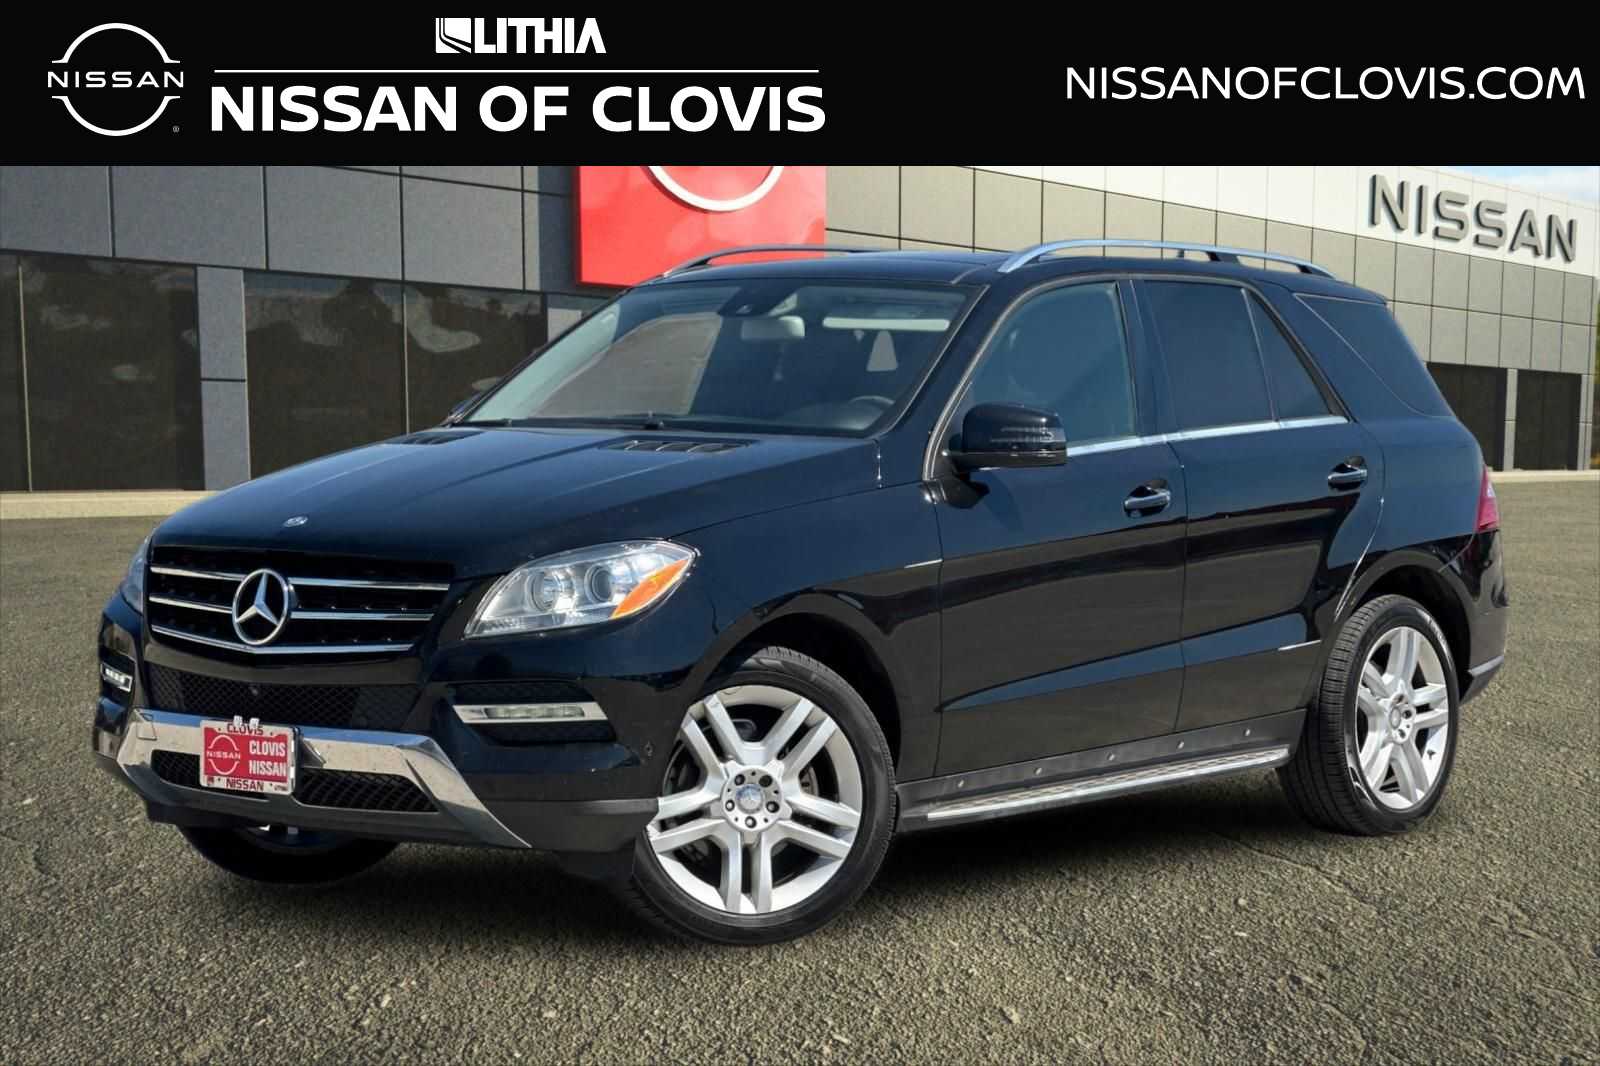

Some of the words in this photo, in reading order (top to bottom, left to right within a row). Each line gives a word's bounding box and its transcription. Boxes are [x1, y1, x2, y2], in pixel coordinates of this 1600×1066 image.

[1368, 173, 1577, 263] NISSAN
[206, 750, 241, 759] NISSAN
[249, 740, 286, 757] CLOVIS
[249, 760, 287, 777] NISSAN
[226, 778, 264, 791] NISSAN
